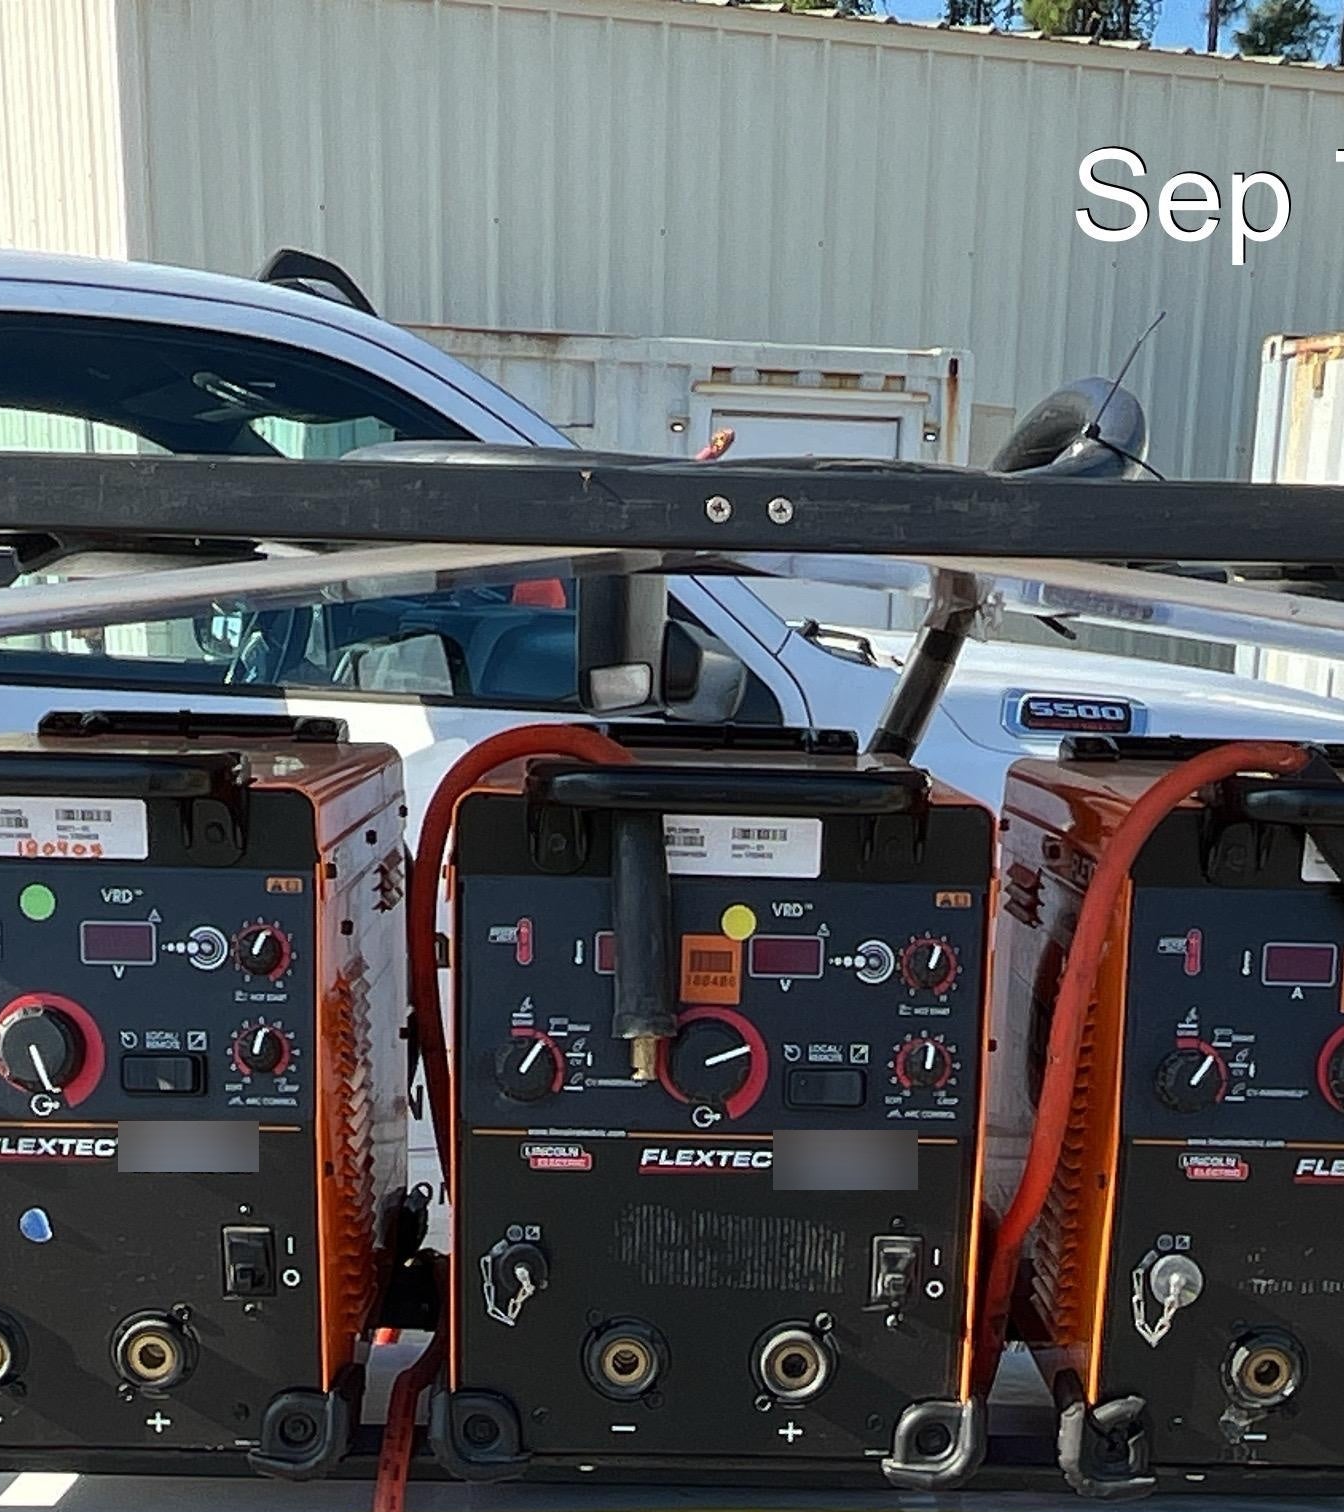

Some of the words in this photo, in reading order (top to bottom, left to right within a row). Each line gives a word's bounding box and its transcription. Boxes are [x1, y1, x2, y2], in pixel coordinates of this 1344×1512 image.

[1030, 702, 1125, 720] 5500
[112, 965, 125, 979] V
[779, 979, 792, 992] V
[1291, 987, 1304, 1000] A
[524, 1146, 579, 1157] LINCOLN
[640, 1148, 773, 1168] FLEXTEC
[1182, 1155, 1237, 1168] LINCOLN
